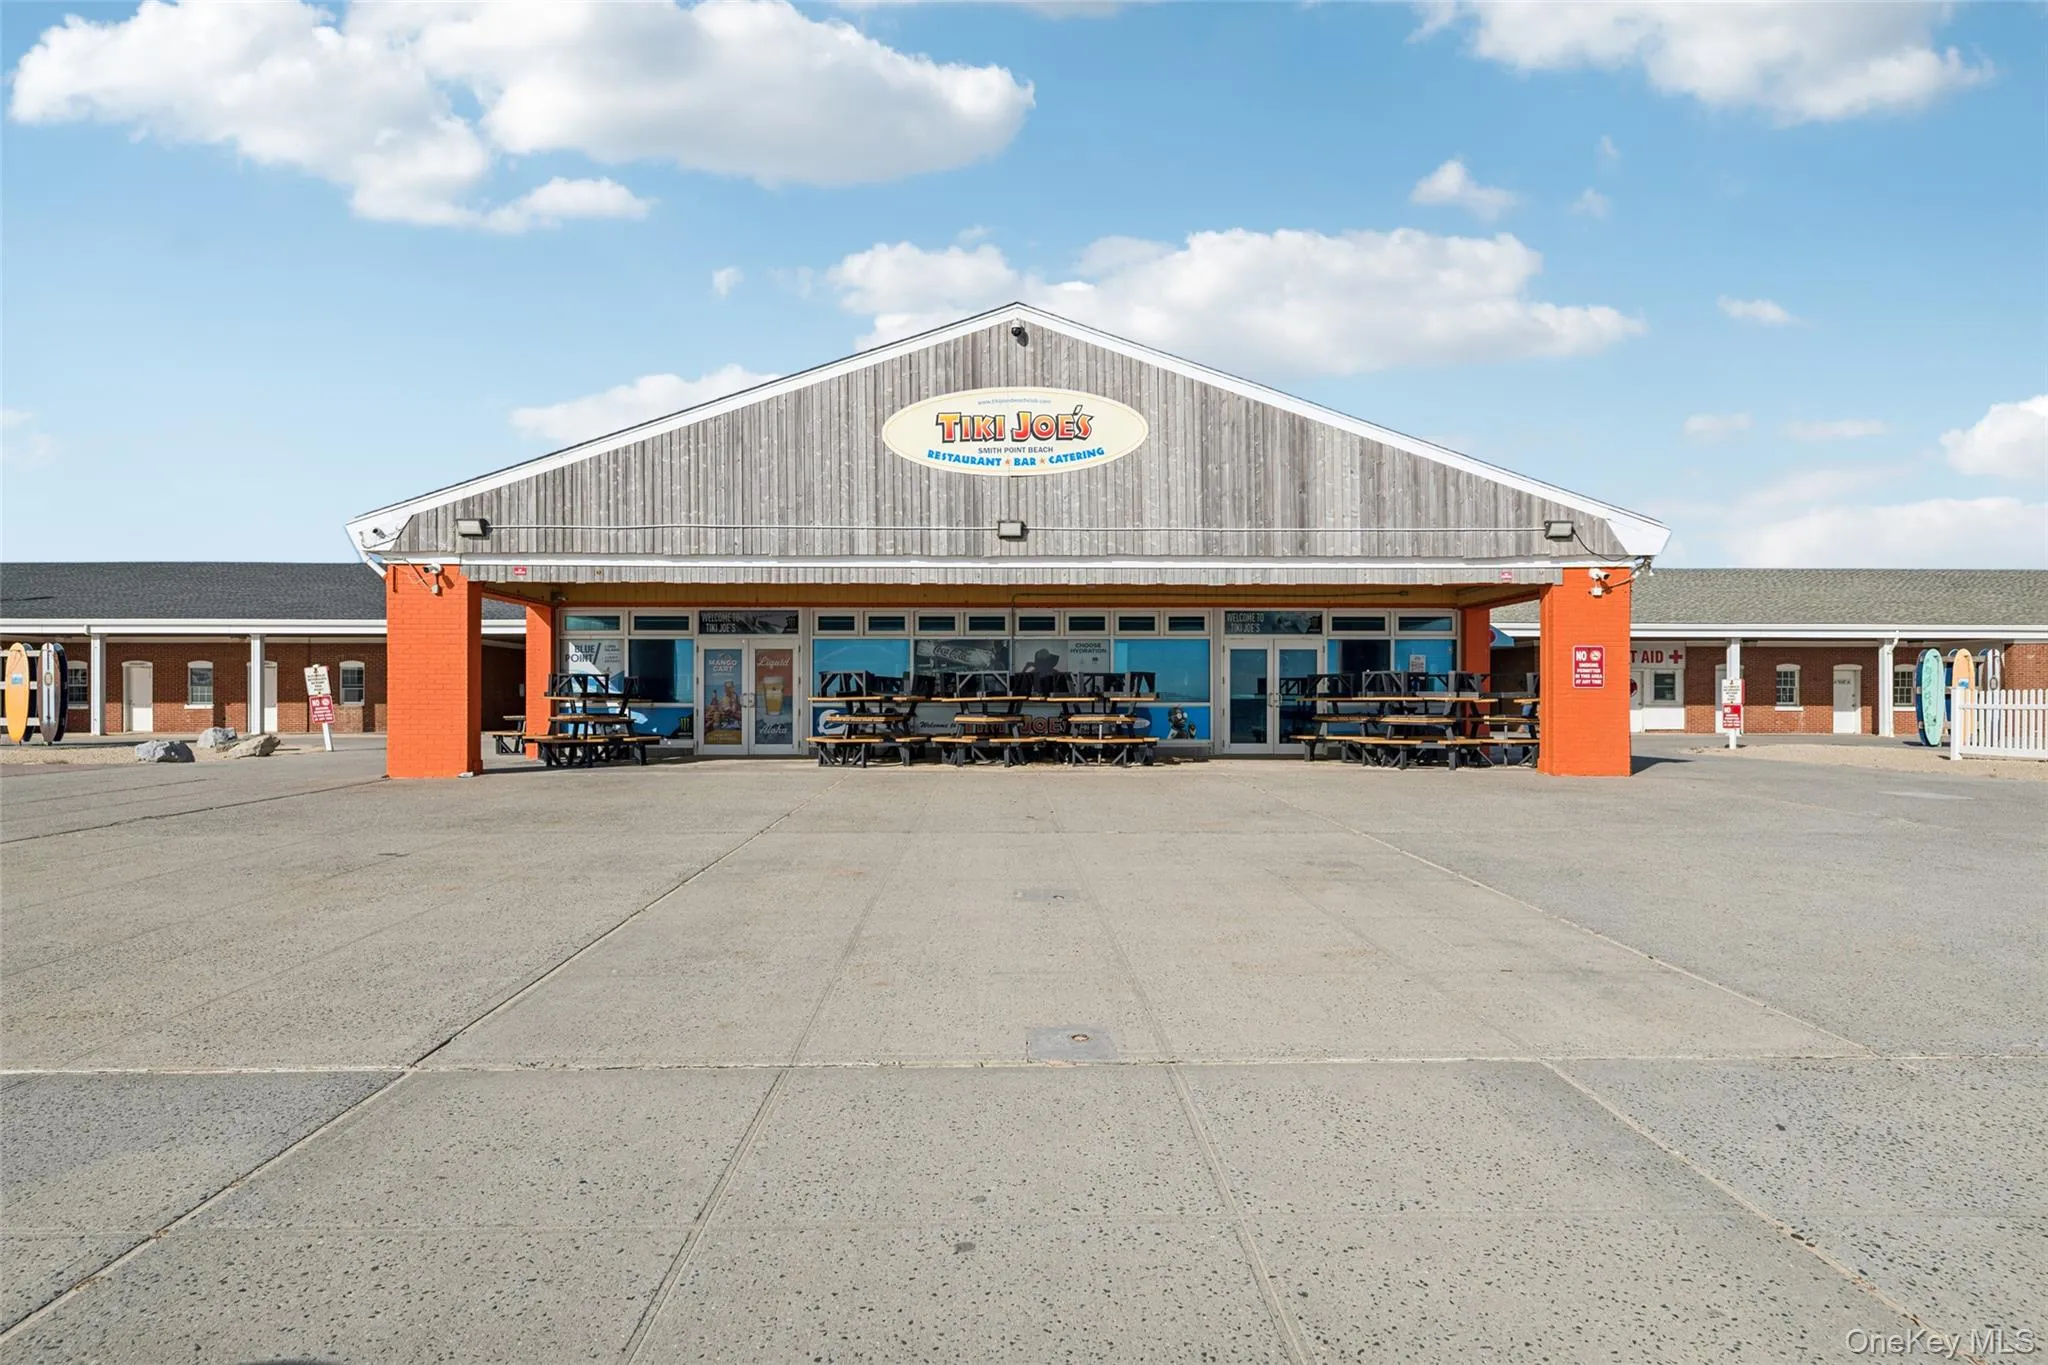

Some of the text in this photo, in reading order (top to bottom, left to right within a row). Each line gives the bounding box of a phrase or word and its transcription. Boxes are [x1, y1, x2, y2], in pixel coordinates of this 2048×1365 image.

[935, 404, 1095, 444] TIKI JOE'S
[927, 447, 1105, 466] RESTAURANT BAR CATERING
[701, 612, 734, 622] WELCOME
[1226, 612, 1265, 622] WELCOME TO
[706, 623, 718, 633] TIKI
[1231, 624, 1242, 633] TIKI
[574, 644, 596, 653] BLUE
[565, 654, 594, 662] POINT
[1575, 650, 1588, 662] NO
[1641, 650, 1664, 664] AID
[757, 656, 791, 670] Liquid
[919, 720, 949, 729] Welcome
